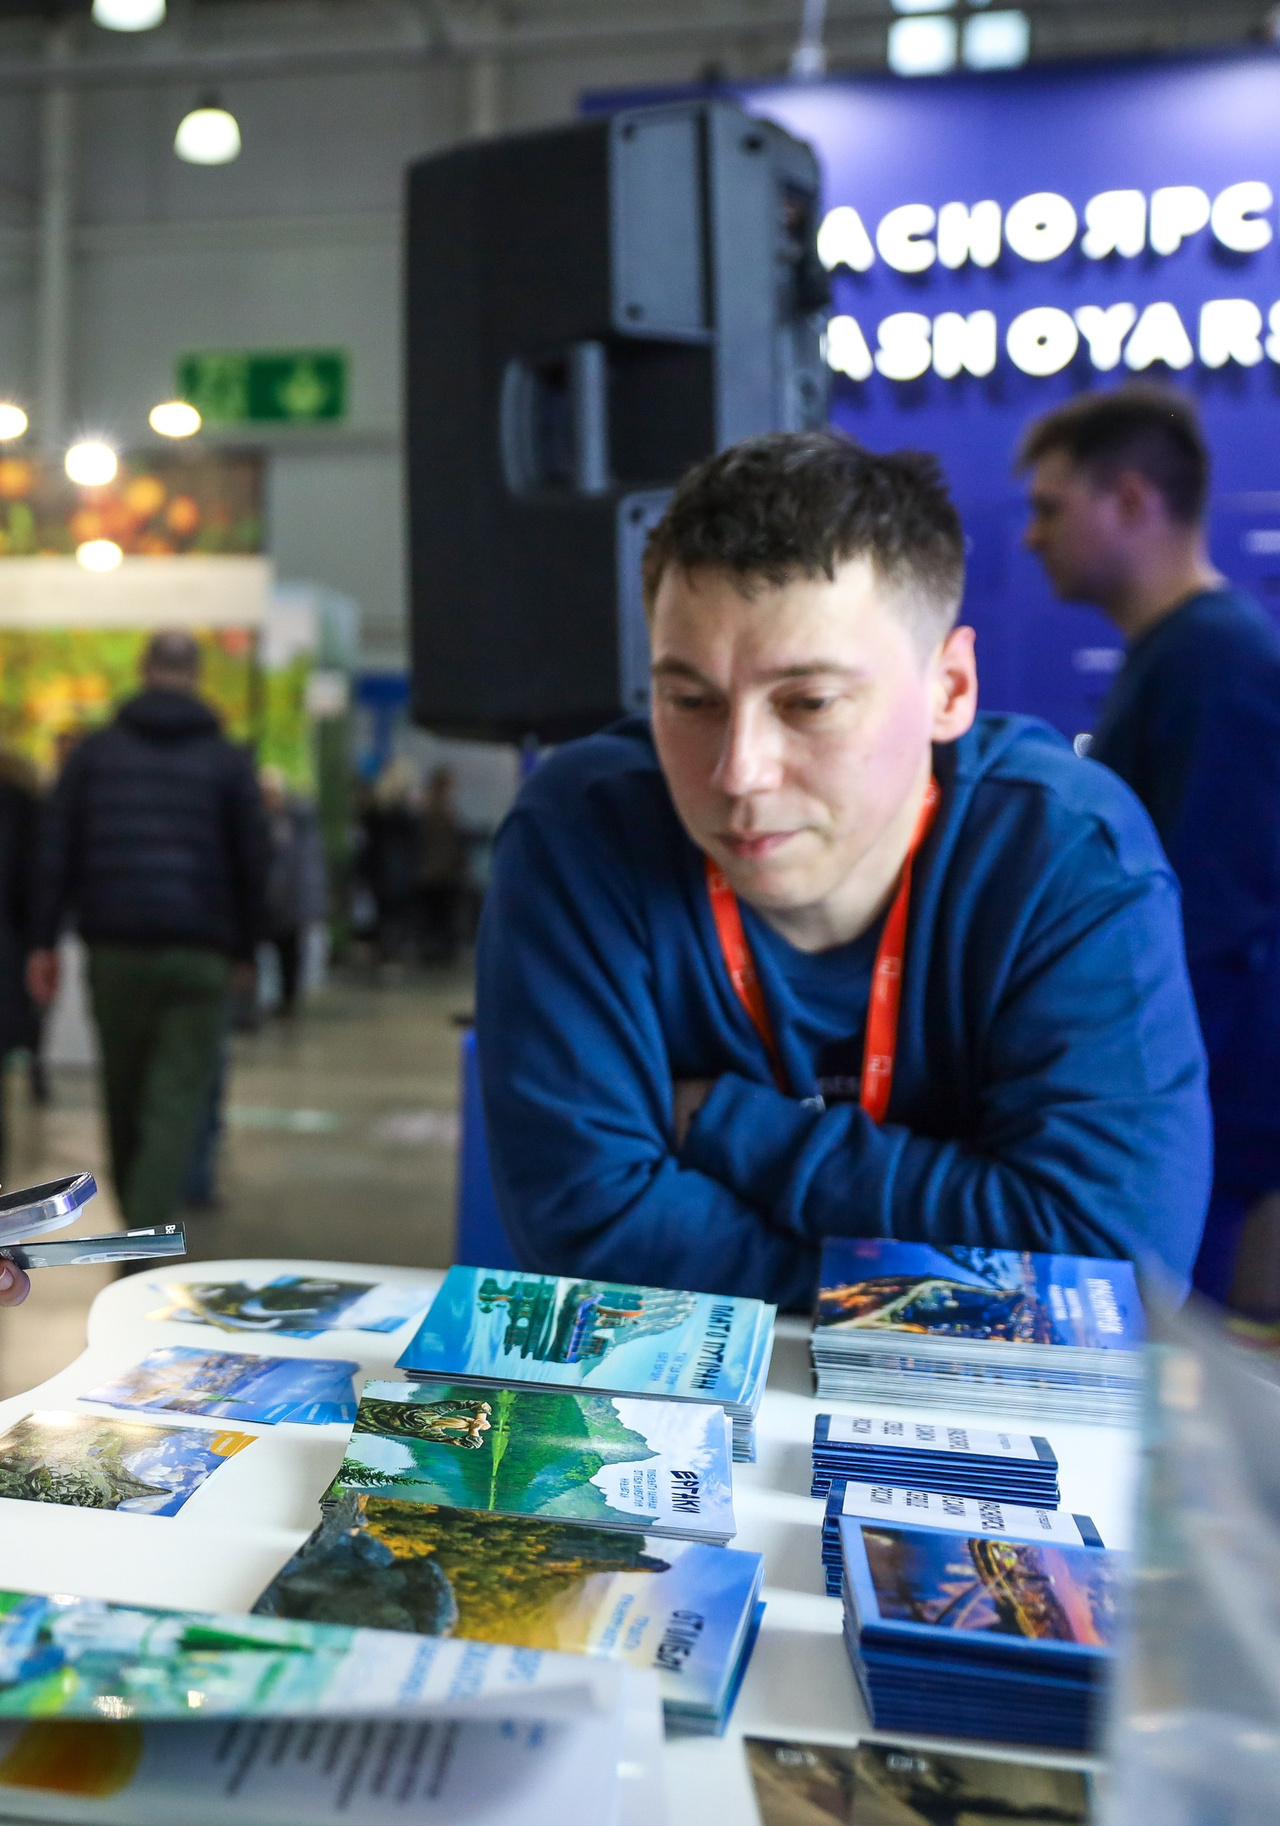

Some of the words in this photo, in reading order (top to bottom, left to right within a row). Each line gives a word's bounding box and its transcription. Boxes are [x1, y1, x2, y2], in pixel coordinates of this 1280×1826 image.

[820, 298, 1280, 382] ASNOYAR
[705, 1303, 735, 1338] ПЛАТО
[689, 1341, 726, 1391] ПУТОРАНА
[670, 1469, 701, 1514] ЕРГАКИ
